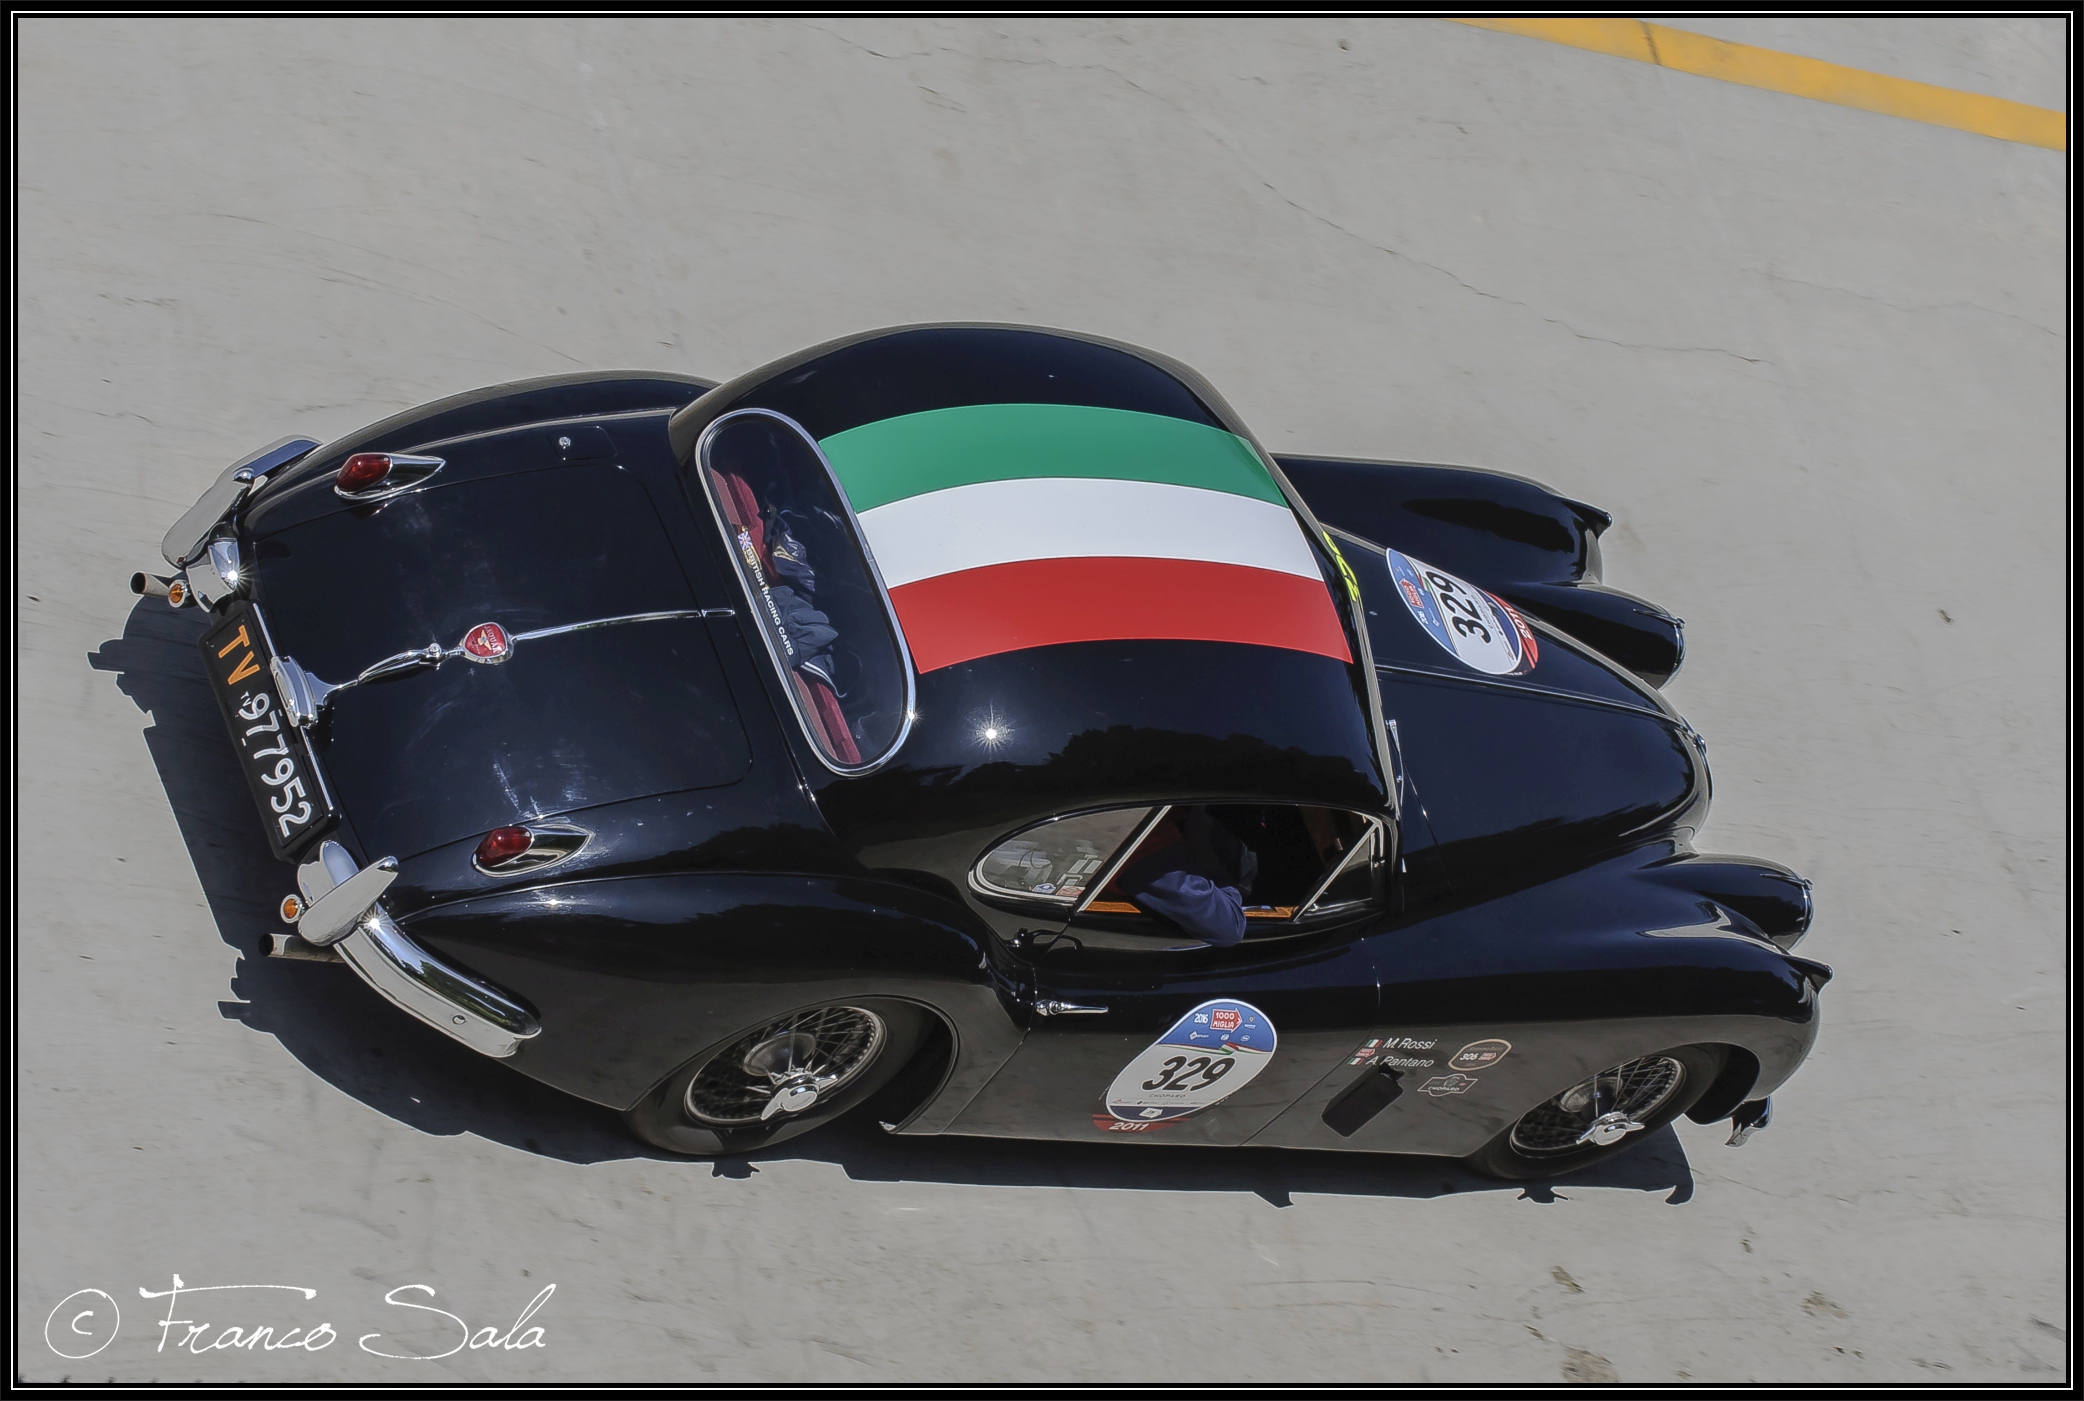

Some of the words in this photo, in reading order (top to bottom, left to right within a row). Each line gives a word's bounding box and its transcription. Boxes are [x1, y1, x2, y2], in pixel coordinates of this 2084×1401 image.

[746, 548, 765, 587] BRITISH
[761, 587, 781, 626] RACING
[778, 627, 794, 656] CARS
[1424, 570, 1492, 644] 329
[1504, 606, 1533, 640] 2011
[218, 624, 261, 685] TV
[240, 691, 252, 707] TV
[238, 693, 312, 838] 977952
[1194, 1013, 1209, 1024] 2016
[1215, 1012, 1235, 1020] 1000
[1212, 1020, 1235, 1029] MIGLIA
[1398, 1038, 1438, 1050] Rossi
[1380, 1055, 1435, 1068] Pantano
[1142, 1056, 1236, 1091] 329
[1109, 1122, 1149, 1131] 2011
